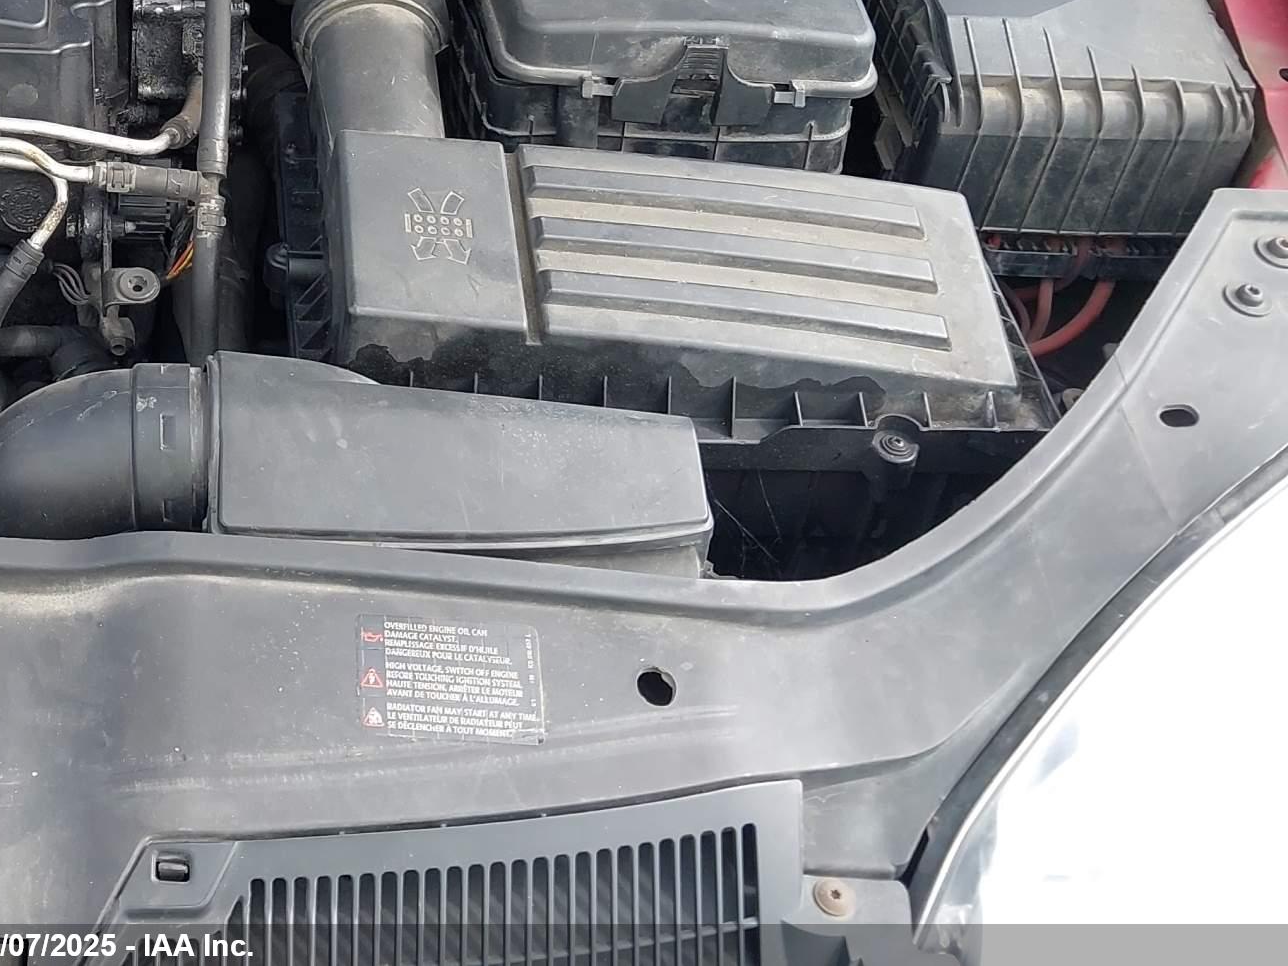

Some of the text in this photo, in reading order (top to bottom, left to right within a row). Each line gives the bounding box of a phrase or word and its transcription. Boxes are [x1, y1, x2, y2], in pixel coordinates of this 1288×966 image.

[384, 622, 488, 636] OVERFILLED ENGINE OIL CAN
[384, 630, 418, 640] DAMAGE
[384, 638, 498, 655] REMPLISSAGE EXCESSIF D'HUILE
[385, 647, 431, 659] DANGEREUX
[432, 651, 453, 660] POUR
[454, 653, 463, 661] LE
[385, 661, 406, 670] HIGH
[445, 666, 474, 676] SWITCH
[475, 668, 489, 677] OFF
[490, 670, 519, 680] ENGINE
[386, 670, 413, 680] BEFORE
[414, 672, 454, 683] TOUCHING
[456, 676, 490, 686] IGNITION
[386, 679, 412, 689] HAUTE
[482, 687, 490, 695] LE
[491, 688, 523, 698] MOTEUR
[386, 688, 413, 698] AVANT
[414, 690, 425, 699] DE
[425, 691, 460, 702] TOUCHER
[386, 702, 425, 713] RADIATOR
[426, 705, 443, 714] FAN
[444, 707, 462, 716] MAY
[463, 708, 487, 717] START
[489, 710, 500, 719] AT
[500, 711, 518, 721] ANY
[387, 711, 523, 729] LE VENTILATEUR DE RADIATEUR PEUT
[387, 720, 396, 729] SE
[397, 720, 445, 732] DÉCLENCHER
[452, 725, 474, 735] TOUT
